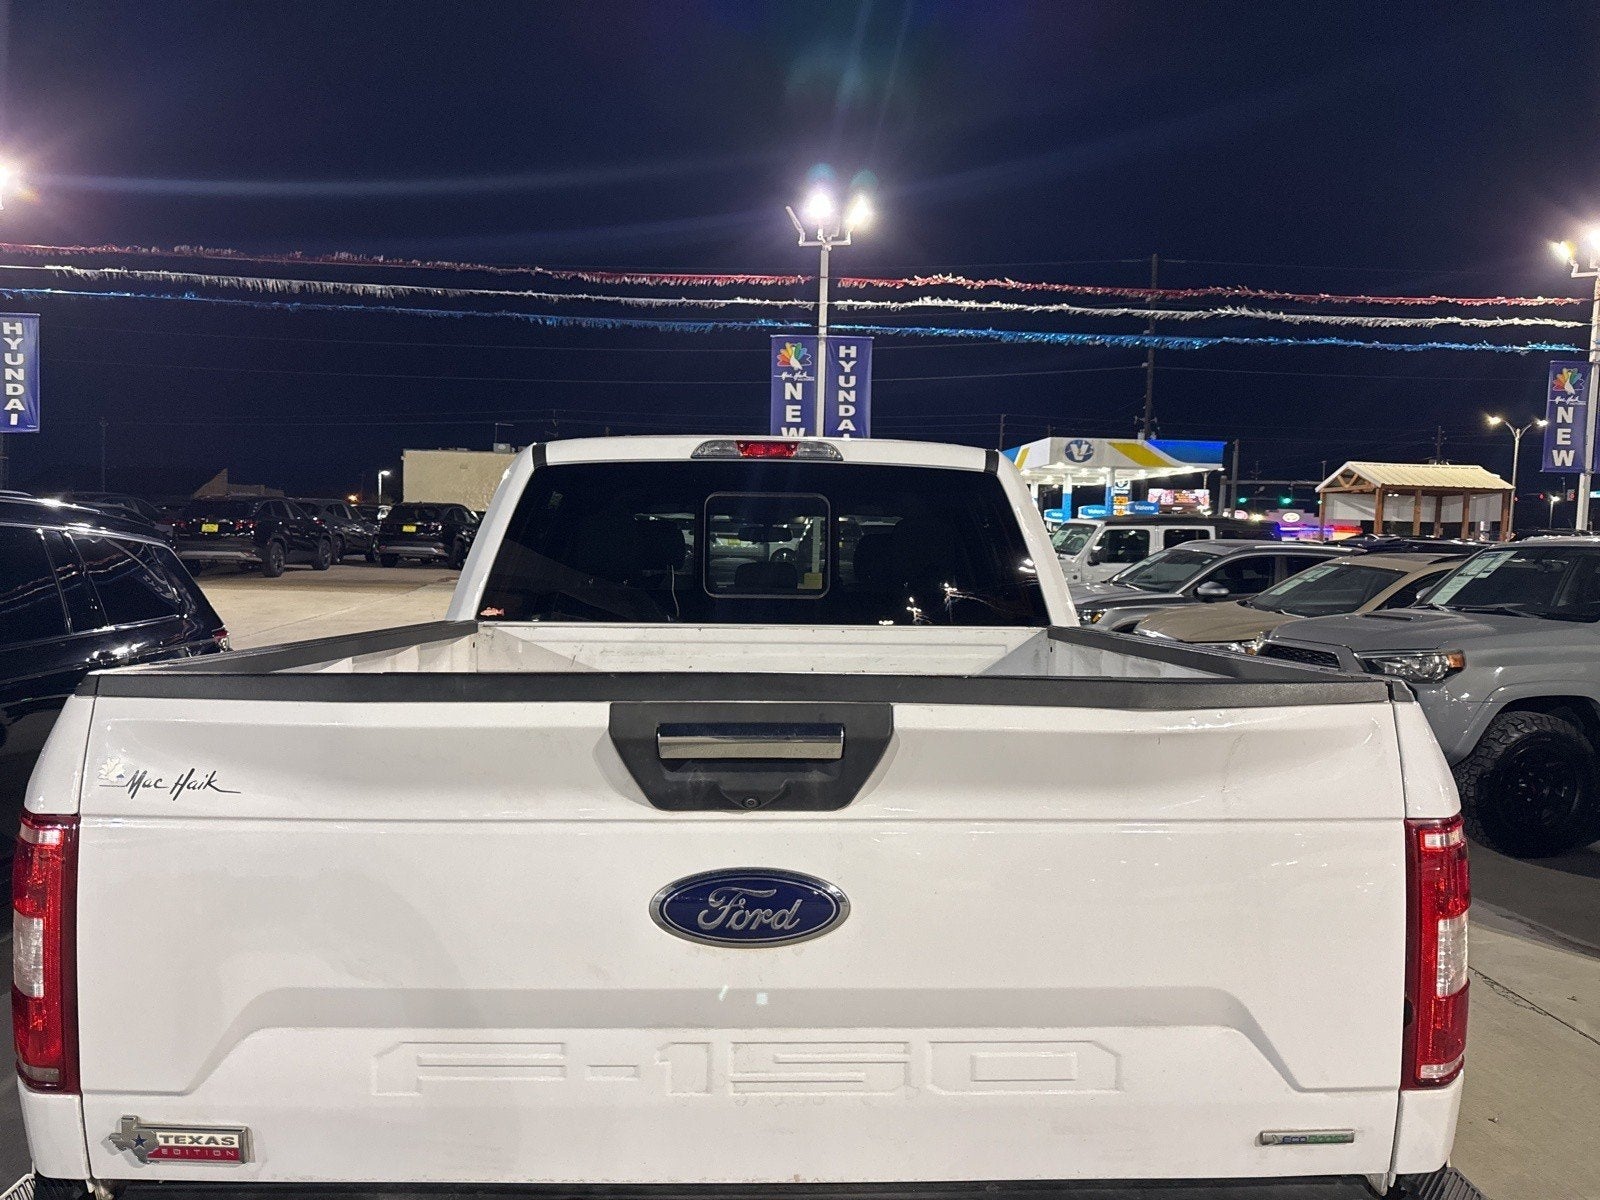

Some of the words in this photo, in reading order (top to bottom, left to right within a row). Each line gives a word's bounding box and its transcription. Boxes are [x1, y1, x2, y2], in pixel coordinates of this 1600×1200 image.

[2, 322, 25, 426] HYUNDAI
[1552, 406, 1575, 467] NEW
[1134, 504, 1155, 512] Valero
[110, 769, 168, 799] Mac
[169, 767, 241, 801] Haik
[697, 886, 803, 931] Ford
[371, 1039, 1124, 1098] F-150
[158, 1133, 236, 1147] TEXAS
[160, 1148, 236, 1157] EDITION
